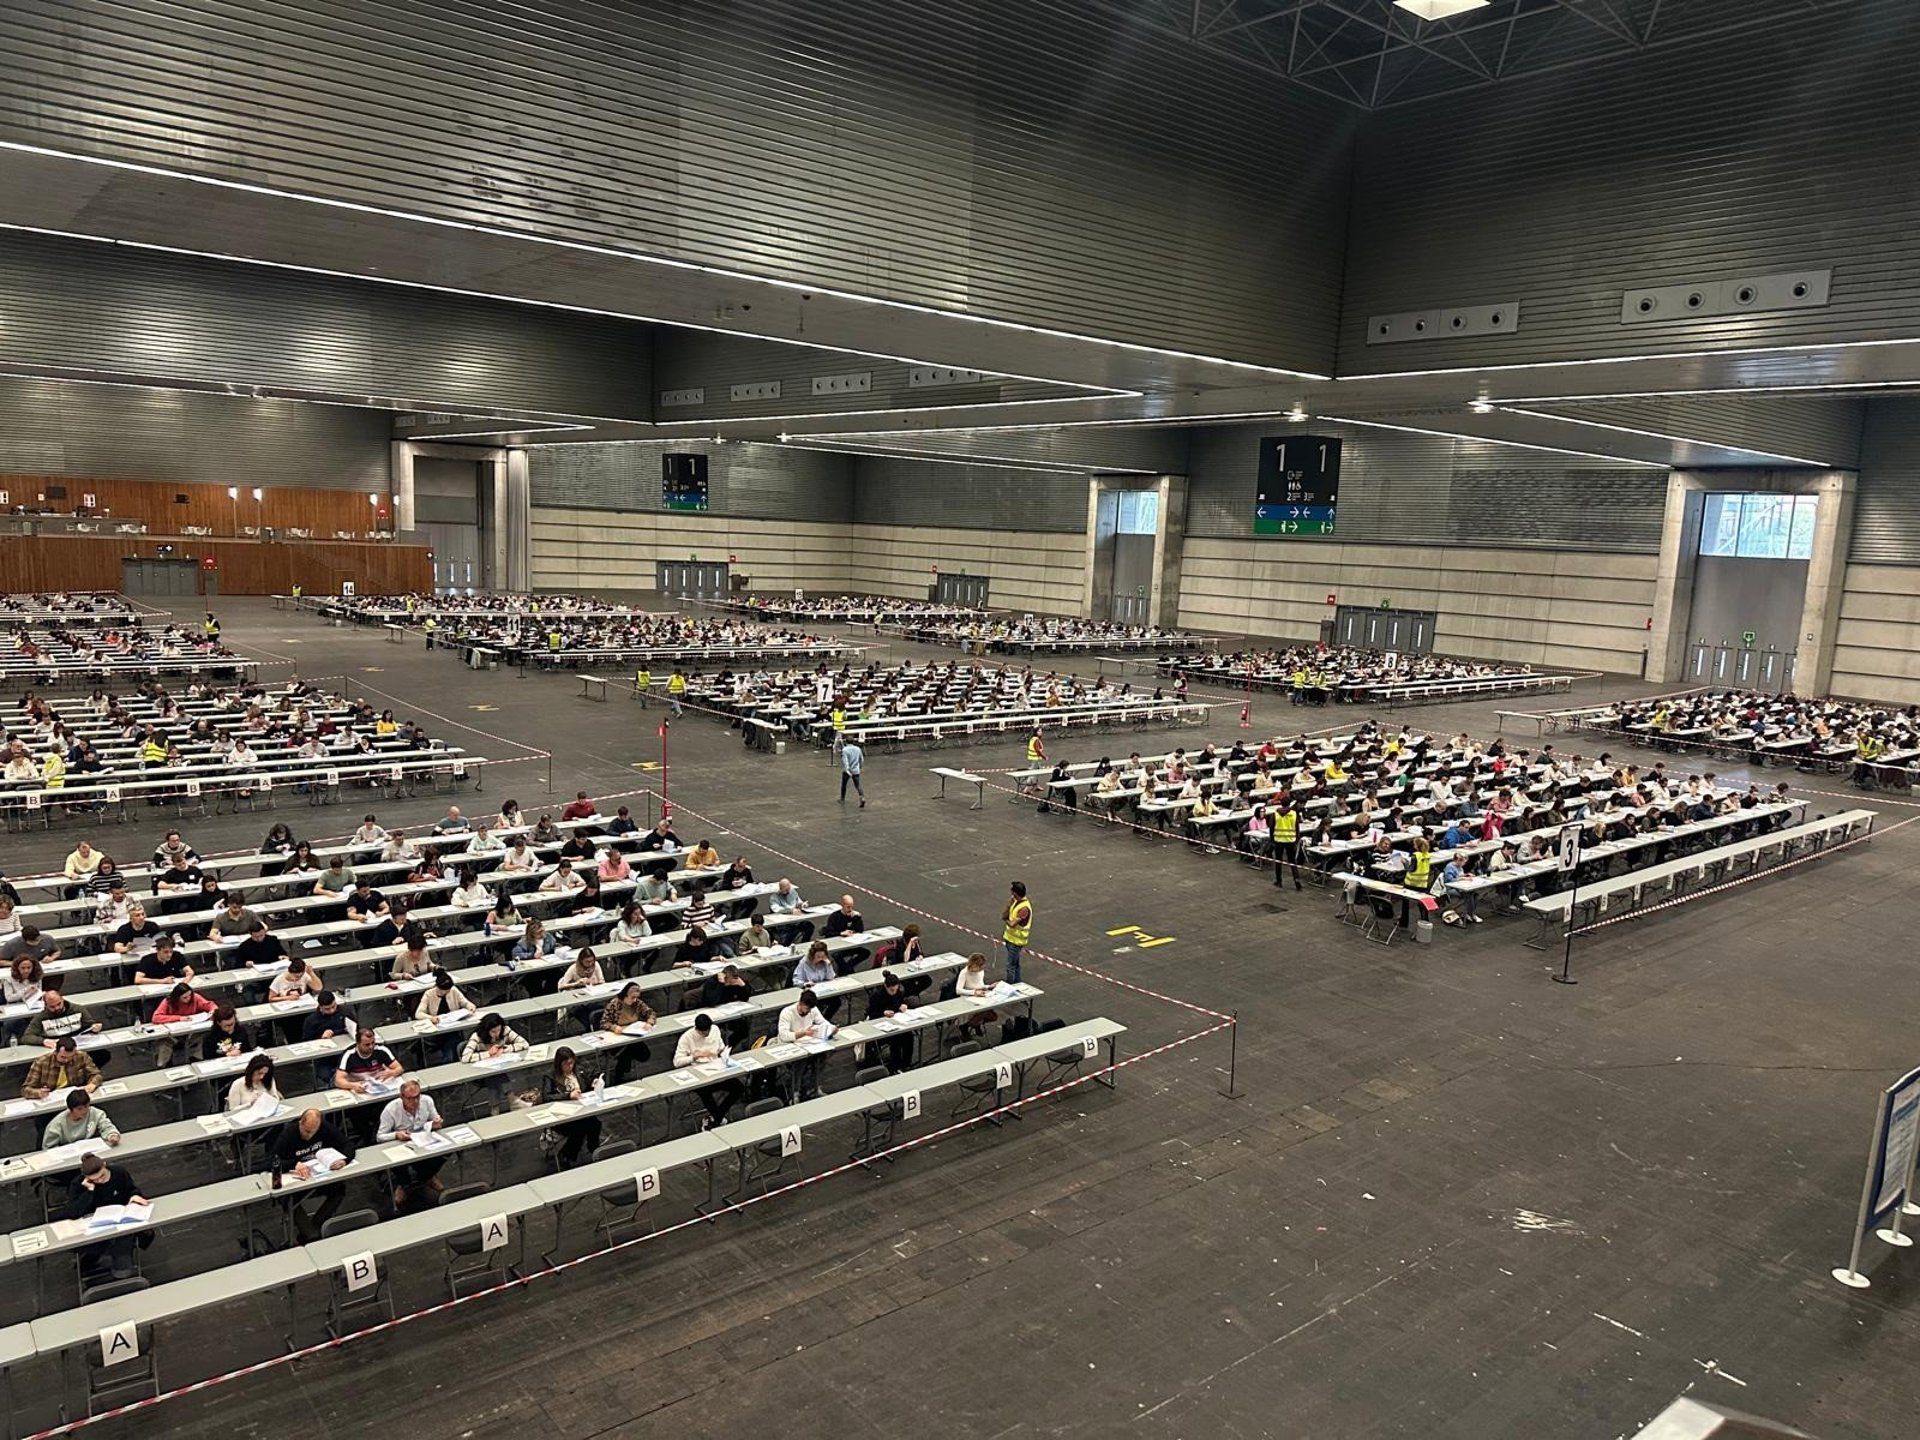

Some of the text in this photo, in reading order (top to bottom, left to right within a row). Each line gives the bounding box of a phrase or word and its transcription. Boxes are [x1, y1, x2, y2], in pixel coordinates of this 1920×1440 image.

[668, 458, 672, 474] 1
[1276, 444, 1286, 472] 1
[1319, 444, 1327, 472] 1
[688, 459, 695, 475] 1
[345, 585, 354, 594] 14
[509, 619, 518, 630] 11
[823, 684, 829, 700] 7
[190, 784, 197, 793] B
[262, 779, 270, 787] A
[29, 796, 37, 804] B
[108, 790, 118, 798] A
[1565, 839, 1574, 867] 3
[1087, 1038, 1095, 1051] B
[999, 1067, 1009, 1081] A
[907, 1096, 917, 1111] B
[785, 1131, 797, 1148] A
[642, 1174, 654, 1192] B
[487, 1222, 503, 1242] A
[353, 1259, 370, 1280] B
[110, 1332, 131, 1354] A
